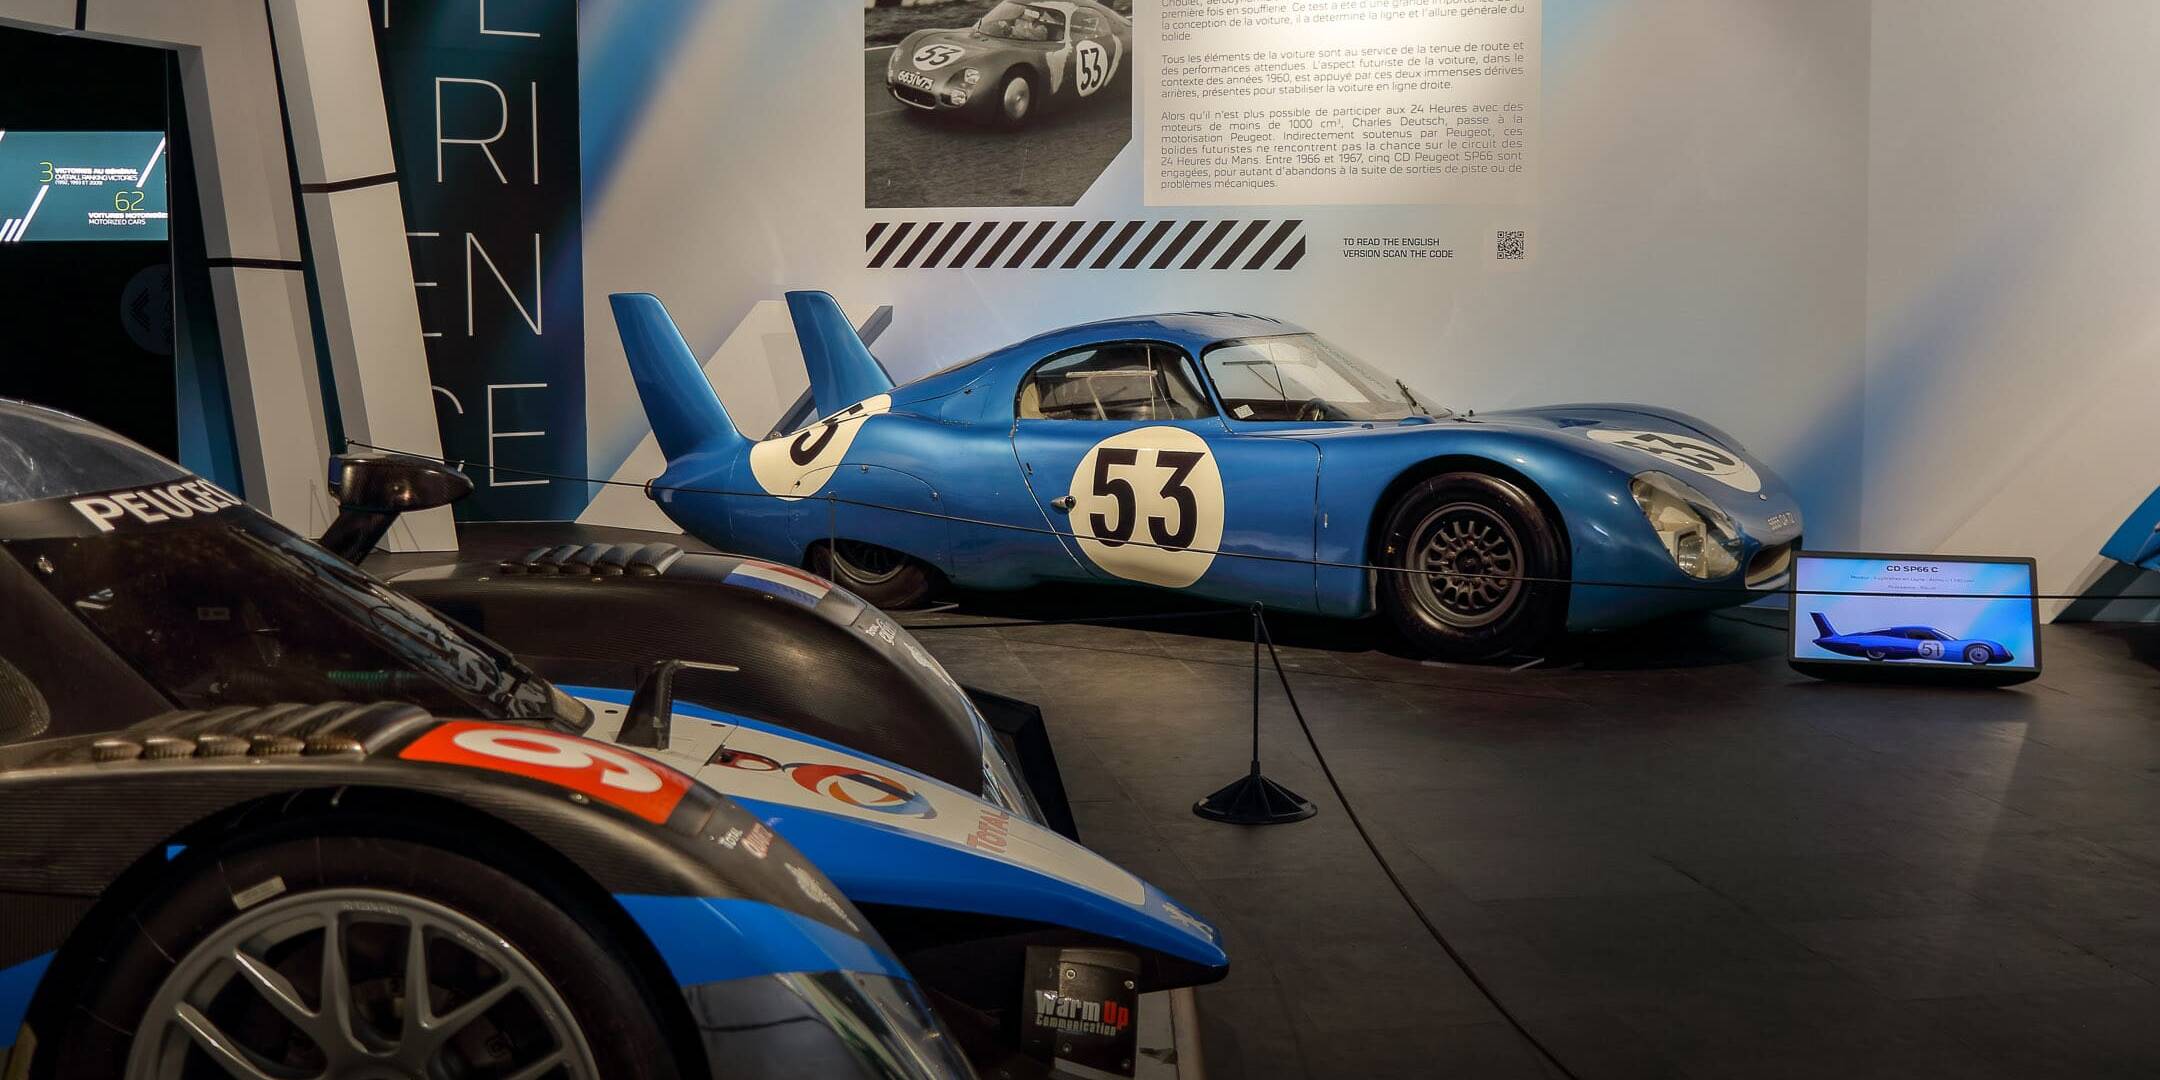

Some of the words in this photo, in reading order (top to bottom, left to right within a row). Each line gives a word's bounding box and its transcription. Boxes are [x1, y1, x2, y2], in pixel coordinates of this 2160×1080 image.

[1162, 54, 1185, 64] Tous
[1188, 54, 1202, 64] les
[1204, 52, 1251, 63] éléments
[1253, 51, 1266, 61] de
[1269, 51, 1278, 61] la
[1280, 50, 1316, 60] voiture
[1318, 48, 1341, 59] sont
[1344, 49, 1358, 58] au
[1361, 47, 1398, 57] service
[1400, 46, 1414, 56] de
[1417, 45, 1426, 55] la
[1430, 44, 1461, 55] tenue
[1464, 43, 1478, 53] de
[1481, 42, 1510, 53] route
[1513, 42, 1525, 52] et
[1080, 47, 1101, 90] 53
[1161, 65, 1179, 75] des
[1182, 63, 1250, 76] performances
[1360, 58, 1404, 69] futuriste
[1408, 57, 1421, 67] de
[1425, 56, 1434, 66] la
[1438, 55, 1479, 67] voiture,
[1483, 54, 1510, 64] dans
[1515, 53, 1524, 63] le
[1161, 76, 1204, 87] contexte
[1206, 76, 1224, 85] des
[1226, 74, 1263, 85] années
[1268, 74, 1292, 84] 1960,
[1295, 73, 1311, 83] est
[1313, 72, 1352, 84] appuyé
[1354, 73, 1371, 83] par
[1374, 72, 1392, 80] ces
[1395, 70, 1421, 80] deux
[1424, 68, 1482, 79] immenses
[1484, 67, 1524, 77] dérives
[1202, 87, 1251, 99] présentes
[1253, 87, 1275, 97] pour
[1279, 85, 1324, 95] stabiliser
[1326, 84, 1335, 94] la
[1338, 83, 1373, 93] voiture
[1376, 84, 1390, 92] en
[1392, 82, 1417, 94] ligne
[1161, 111, 1185, 121] Alors
[1214, 110, 1239, 120] n'est
[1243, 109, 1265, 121] plus
[1269, 108, 1311, 120] possible
[1315, 107, 1328, 117] de
[1333, 106, 1381, 118] participer
[1386, 107, 1406, 116] aux
[1410, 105, 1424, 115] 24
[1429, 104, 1468, 114] Heures
[1472, 105, 1498, 113] avec
[1503, 103, 1524, 113] des
[435, 76, 540, 185] RI
[1161, 122, 1202, 132] moteurs
[1209, 121, 1222, 131] de
[1230, 120, 1261, 130] moins
[1289, 119, 1313, 129] 1000
[1352, 118, 1392, 128] Charles
[1400, 116, 1448, 128] Deutsch,
[1457, 117, 1489, 127] passe
[1161, 133, 1223, 143] motorisation
[1283, 130, 1355, 141] Indirectement
[1363, 129, 1413, 139] soutenus
[1420, 130, 1438, 140] par
[1447, 127, 1495, 139] Peugeot,
[1503, 128, 1523, 137] ces
[1161, 145, 1198, 155] bolides
[1201, 144, 1252, 154] futuristes
[1256, 145, 1270, 153] ne
[1274, 142, 1337, 153] rencontrent
[1341, 143, 1362, 153] pas
[1366, 141, 1375, 151] la
[1380, 141, 1421, 151] chance
[1425, 142, 1443, 150] sur
[1447, 140, 1458, 150] le
[1461, 139, 1497, 149] circuit
[1501, 139, 1523, 149] des
[1161, 155, 1173, 165] 24
[1177, 155, 1211, 165] Heures
[1215, 155, 1228, 165] du
[1266, 154, 1292, 164] Entre
[1297, 154, 1320, 164] 1966
[1324, 153, 1334, 163] et
[1340, 153, 1364, 164] 1967,
[1368, 153, 1390, 164] cinq
[1394, 153, 1410, 162] CD
[1415, 152, 1459, 164] Peugeot
[1464, 152, 1493, 161] SP66
[1497, 151, 1522, 161] sont
[40, 162, 53, 182] 3
[1161, 168, 1211, 180] engagées,
[1214, 169, 1237, 179] pour
[1239, 167, 1273, 177] autant
[1349, 166, 1358, 176] la
[1361, 166, 1387, 175] suite
[1389, 165, 1403, 175] de
[1406, 165, 1442, 175] sorties
[1445, 165, 1458, 174] de
[1461, 164, 1488, 176] piste
[1490, 165, 1505, 174] ou
[1508, 164, 1522, 173] de
[1161, 179, 1212, 191] problèmes
[115, 191, 145, 211] 62
[1343, 238, 1354, 246] TO
[1356, 238, 1380, 246] READ
[1382, 238, 1399, 246] THE
[1402, 238, 1440, 246] ENGLISH
[1343, 250, 1380, 258] VERSION
[1383, 250, 1407, 258] SCAN
[1410, 250, 1427, 258] THE
[1429, 250, 1454, 258] CODE
[69, 478, 243, 533] PEUGEO
[1089, 447, 1206, 552] 53
[1903, 565, 1929, 573] SP66
[1921, 642, 1942, 657] 51
[1035, 989, 1101, 1023] Warm
[1103, 1000, 1129, 1031] Up
